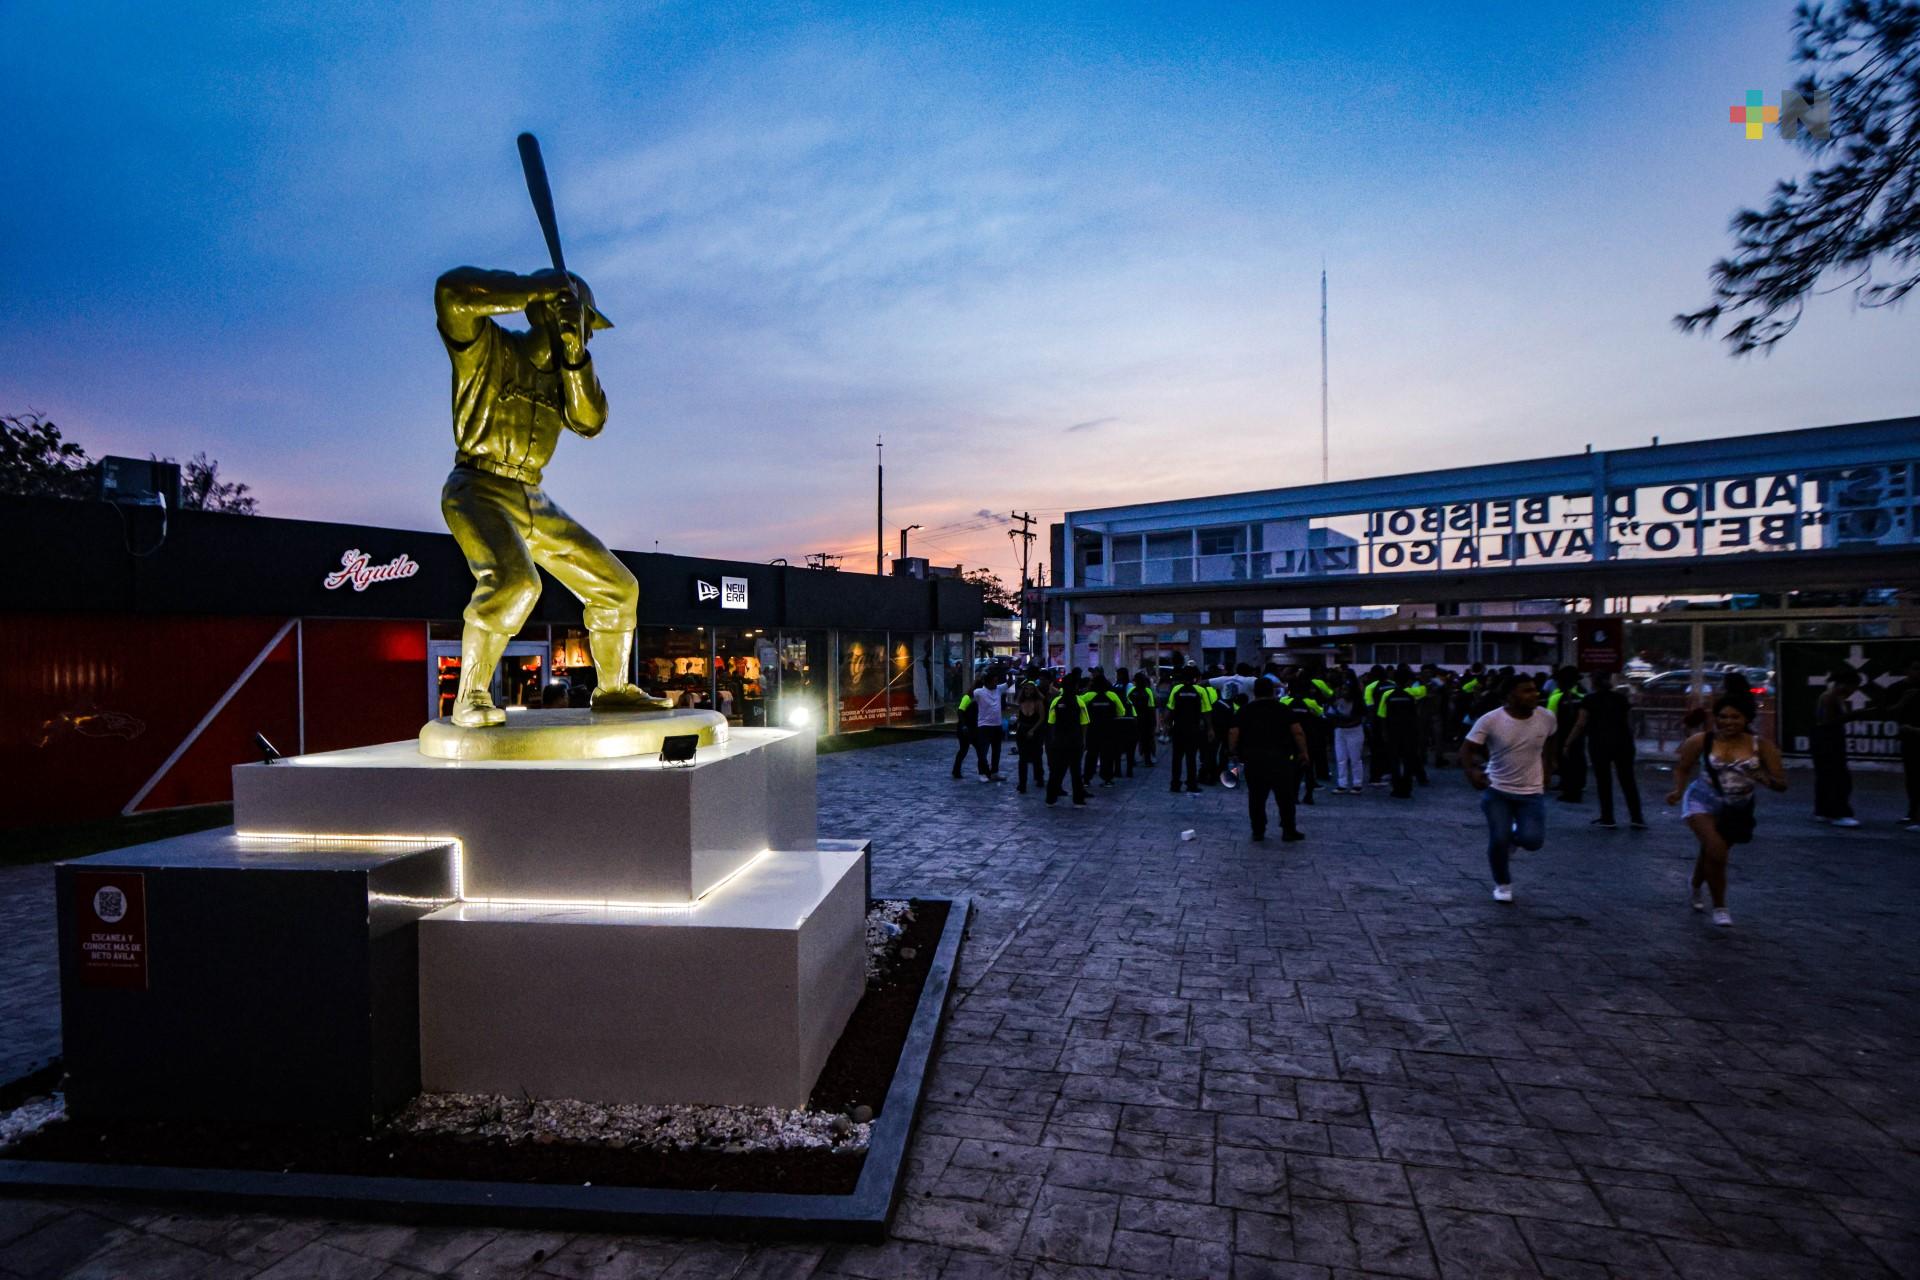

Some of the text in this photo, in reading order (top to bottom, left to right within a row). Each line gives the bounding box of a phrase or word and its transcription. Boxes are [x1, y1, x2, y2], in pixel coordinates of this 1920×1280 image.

[726, 583, 745, 593] NEW
[726, 593, 745, 602] ERA
[128, 934, 134, 942] Y
[82, 942, 112, 951] CONOCE
[131, 944, 142, 952] DE
